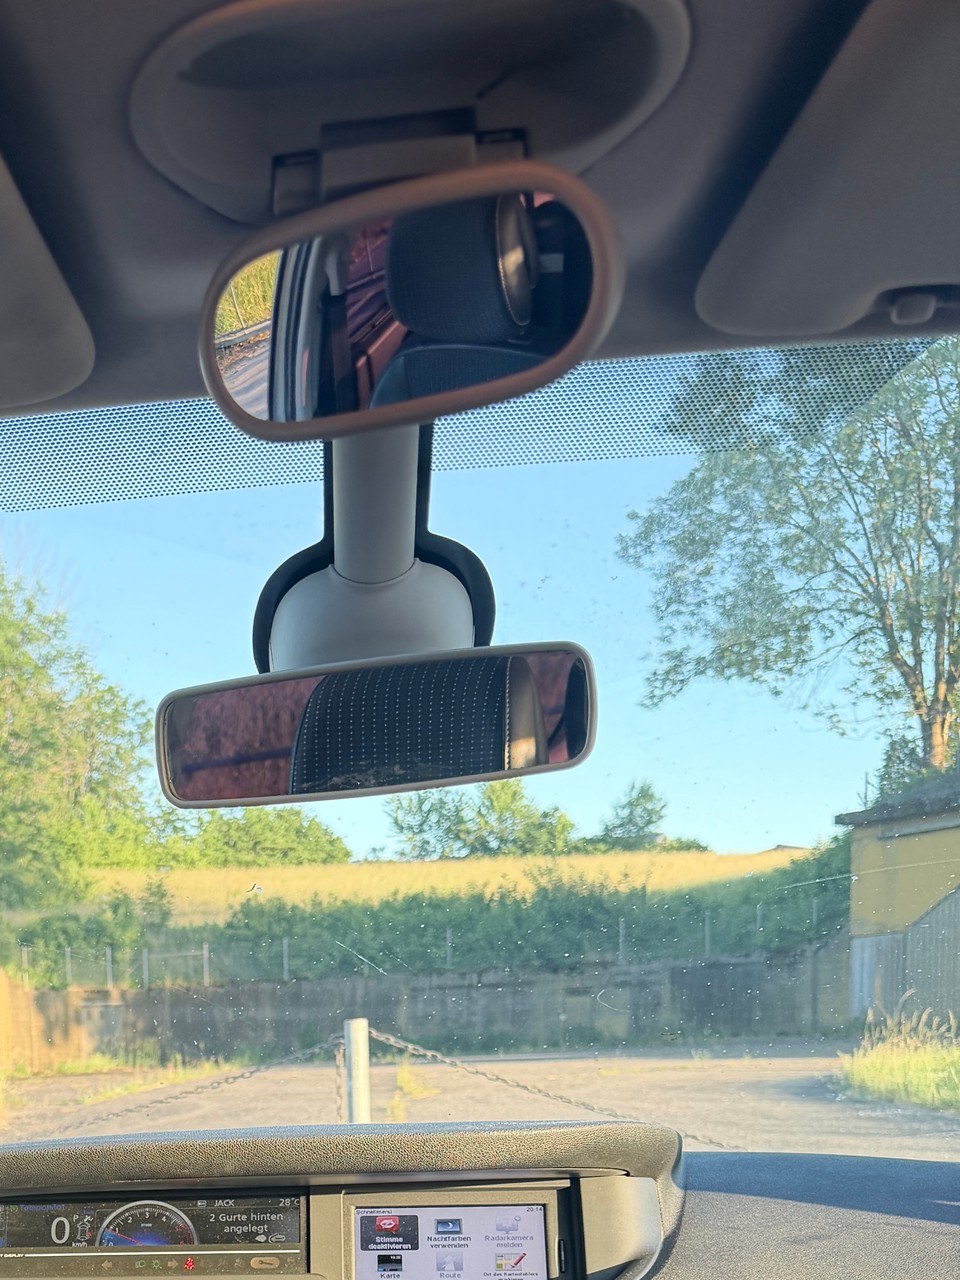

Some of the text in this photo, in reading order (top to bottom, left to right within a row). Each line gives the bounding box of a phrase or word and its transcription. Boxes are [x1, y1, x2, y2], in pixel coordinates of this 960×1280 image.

[20, 1203, 66, 1212] Tempopilot
[214, 1199, 235, 1207] JACK
[73, 1214, 79, 1222] P
[144, 1211, 151, 1219] 3
[209, 1212, 284, 1222] 2 Gurte hinten
[50, 1216, 71, 1244] 0
[223, 1223, 268, 1234] angelegt
